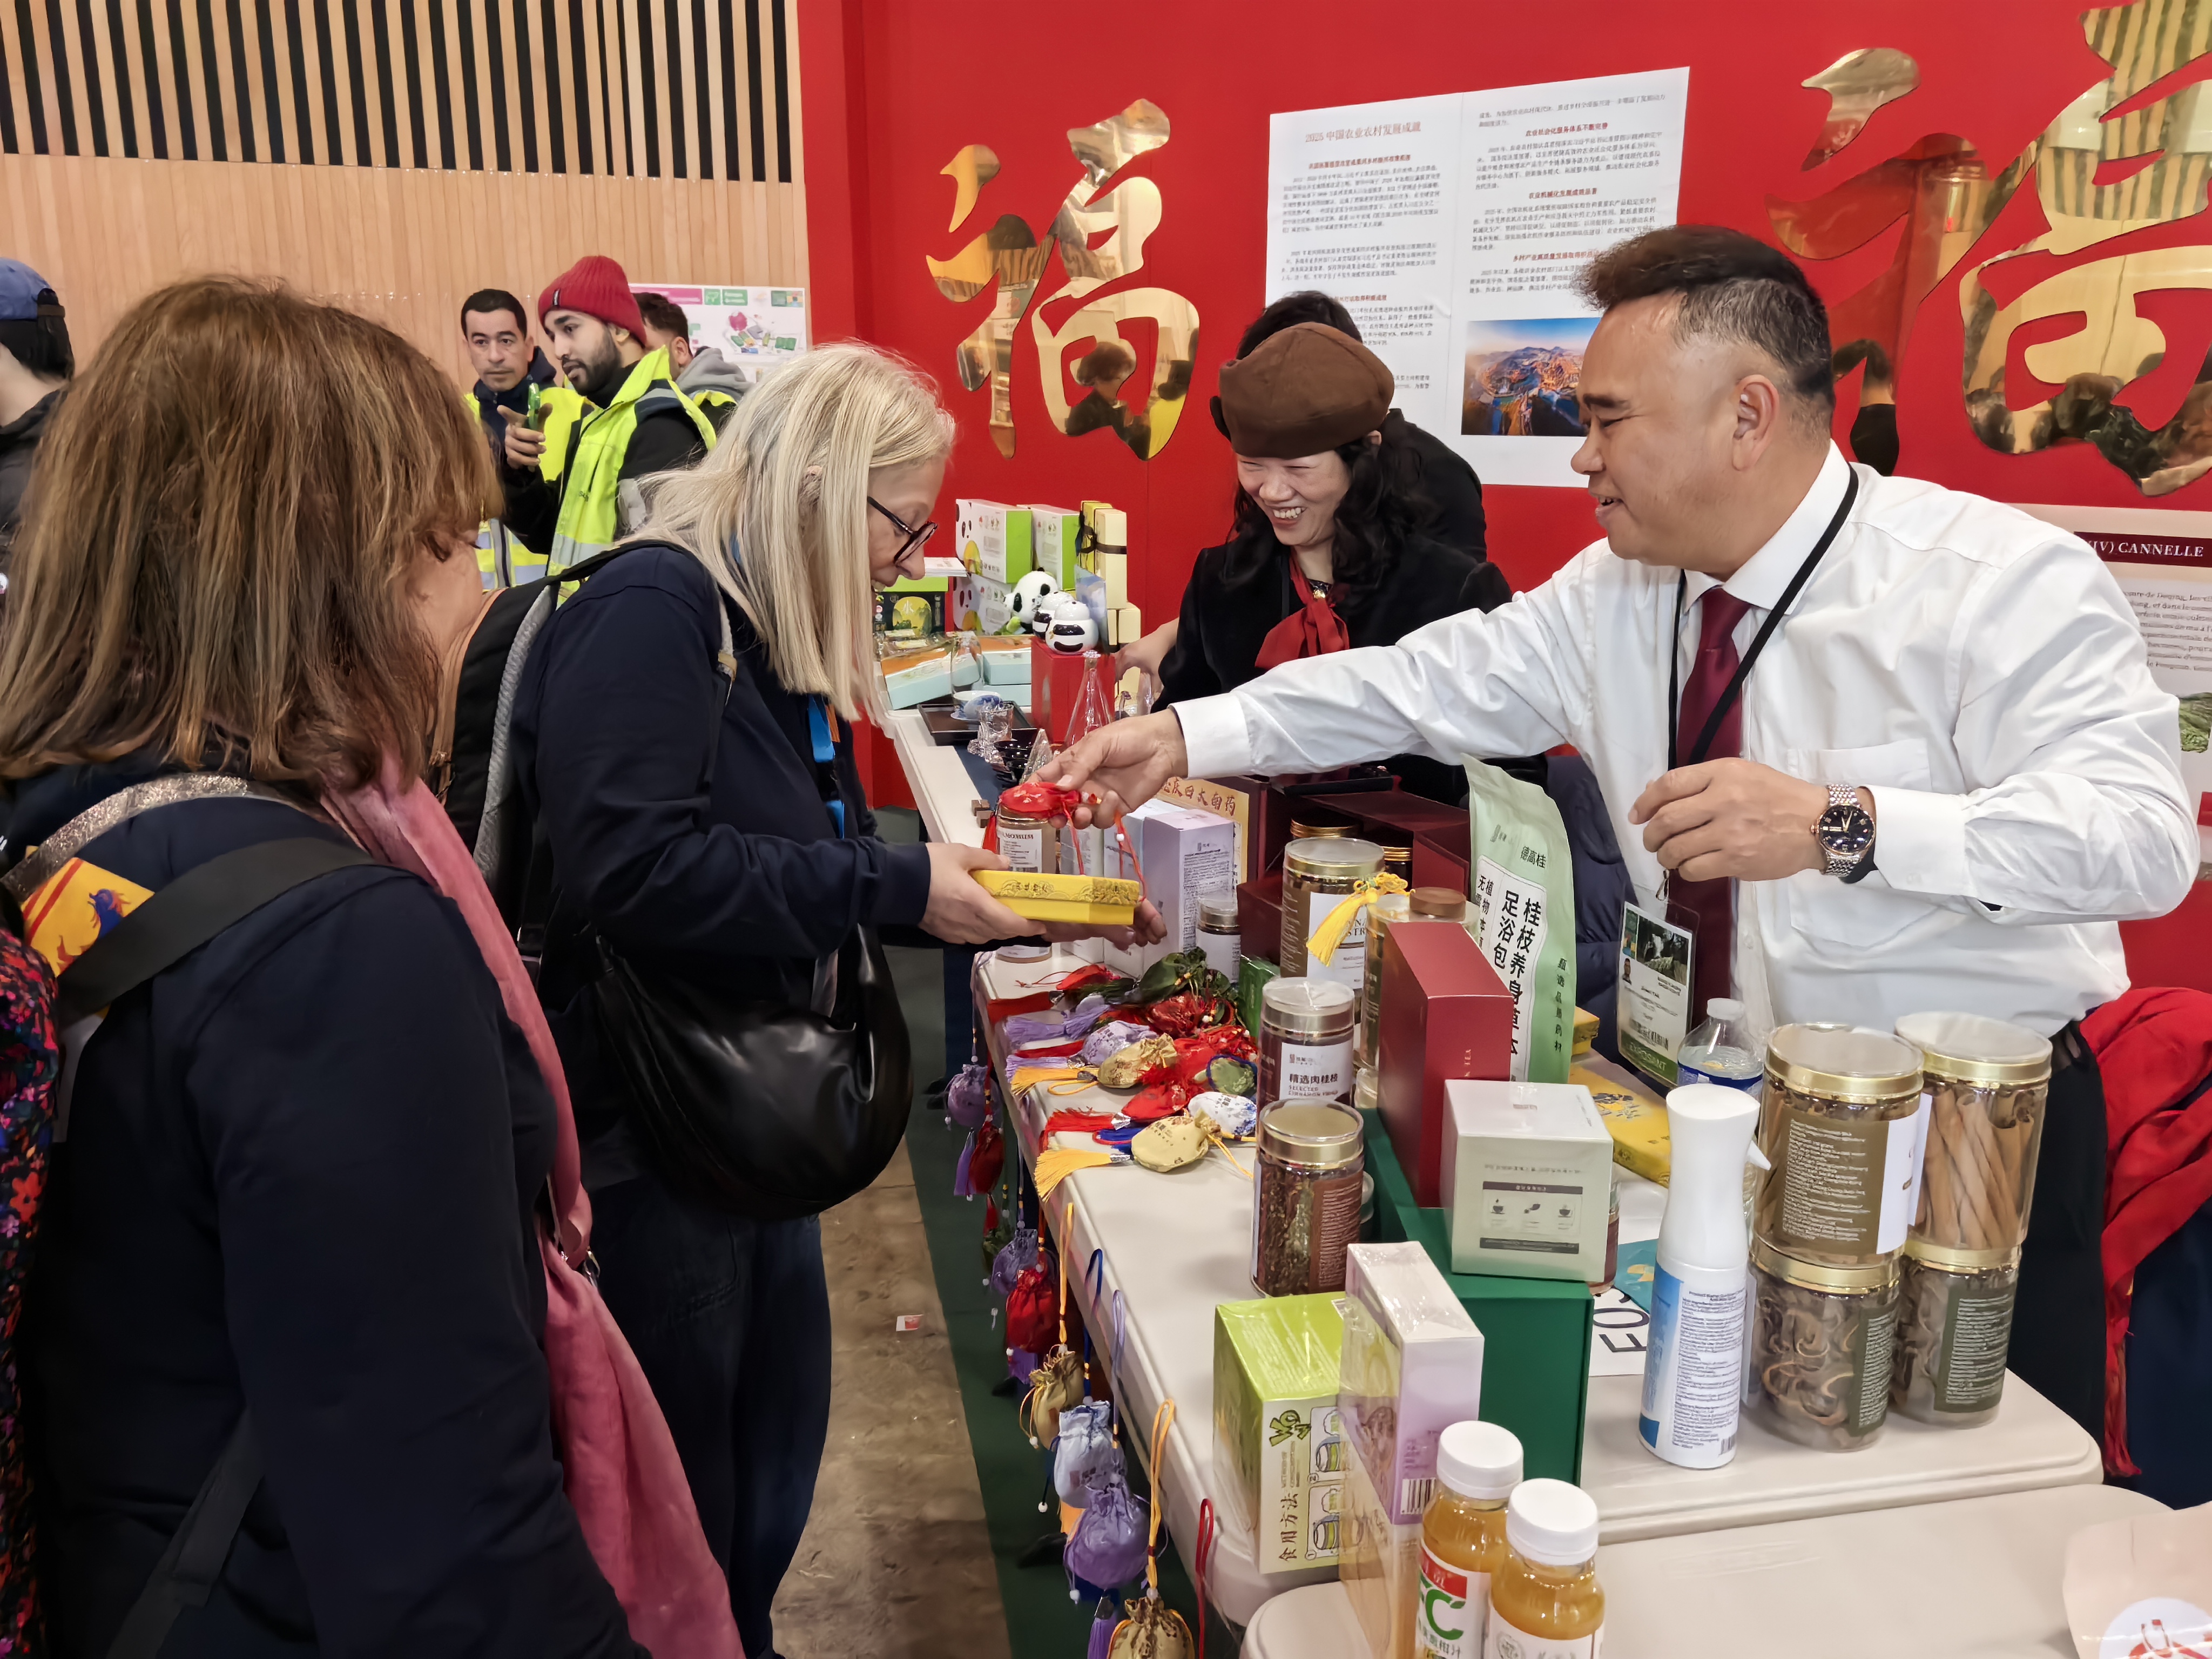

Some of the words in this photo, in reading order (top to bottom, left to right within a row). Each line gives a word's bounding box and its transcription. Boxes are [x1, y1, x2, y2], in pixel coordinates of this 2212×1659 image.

[926, 98, 1199, 461] 福
[2088, 541, 2114, 554] IV)
[2118, 542, 2204, 557] CANNELLE
[1494, 890, 1519, 969] 足浴包
[1278, 1493, 1298, 1562] 食用方法
